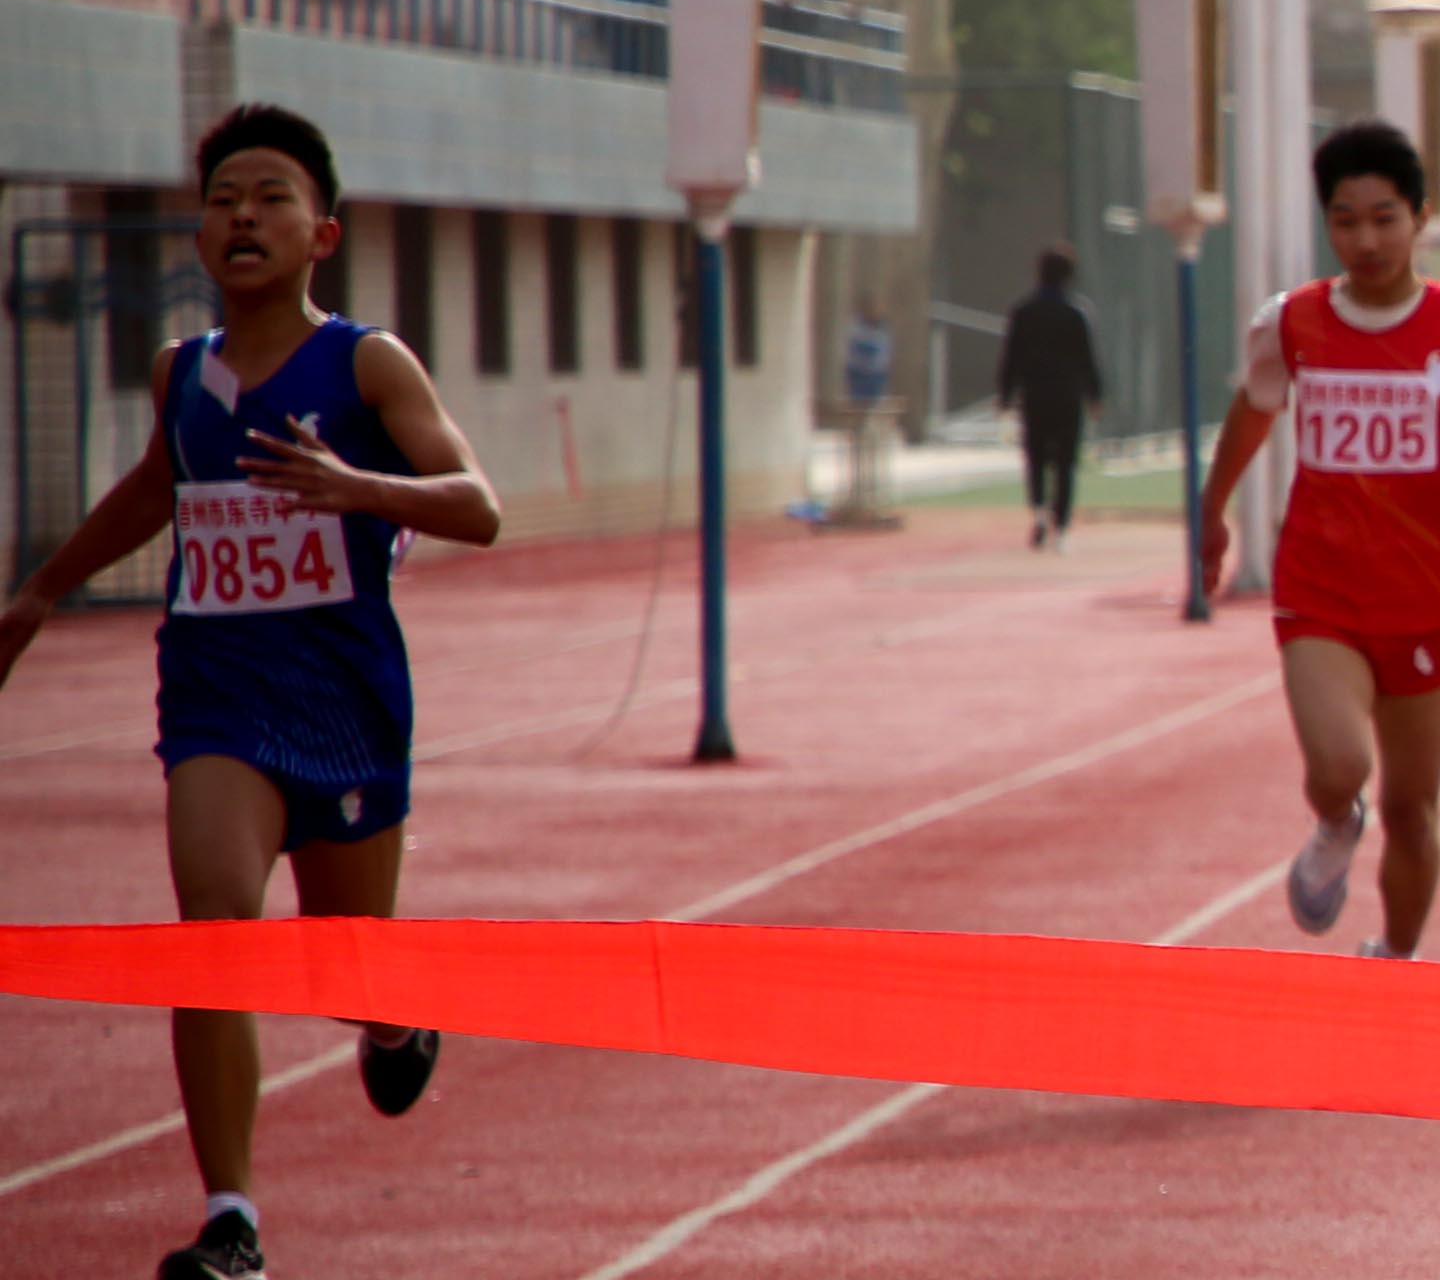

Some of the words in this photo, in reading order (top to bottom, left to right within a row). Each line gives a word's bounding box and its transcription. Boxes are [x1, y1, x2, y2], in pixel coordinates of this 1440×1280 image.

[1308, 410, 1426, 464] 1205
[178, 495, 318, 532] 晋州市东寺中
[184, 529, 335, 606] 0854
